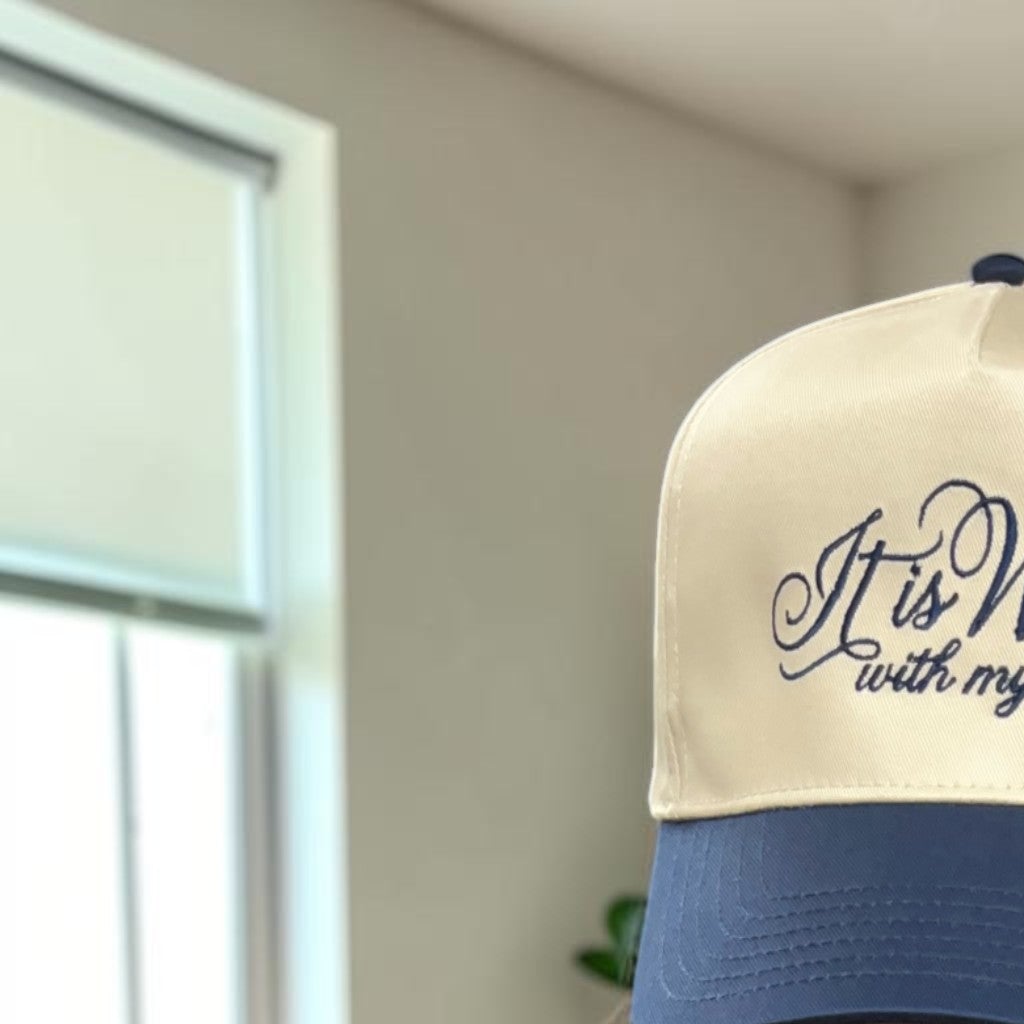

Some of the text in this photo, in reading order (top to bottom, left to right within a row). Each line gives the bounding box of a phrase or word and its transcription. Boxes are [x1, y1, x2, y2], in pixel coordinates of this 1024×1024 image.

[772, 508, 944, 680] It
[891, 560, 959, 630] is
[855, 639, 963, 693] with
